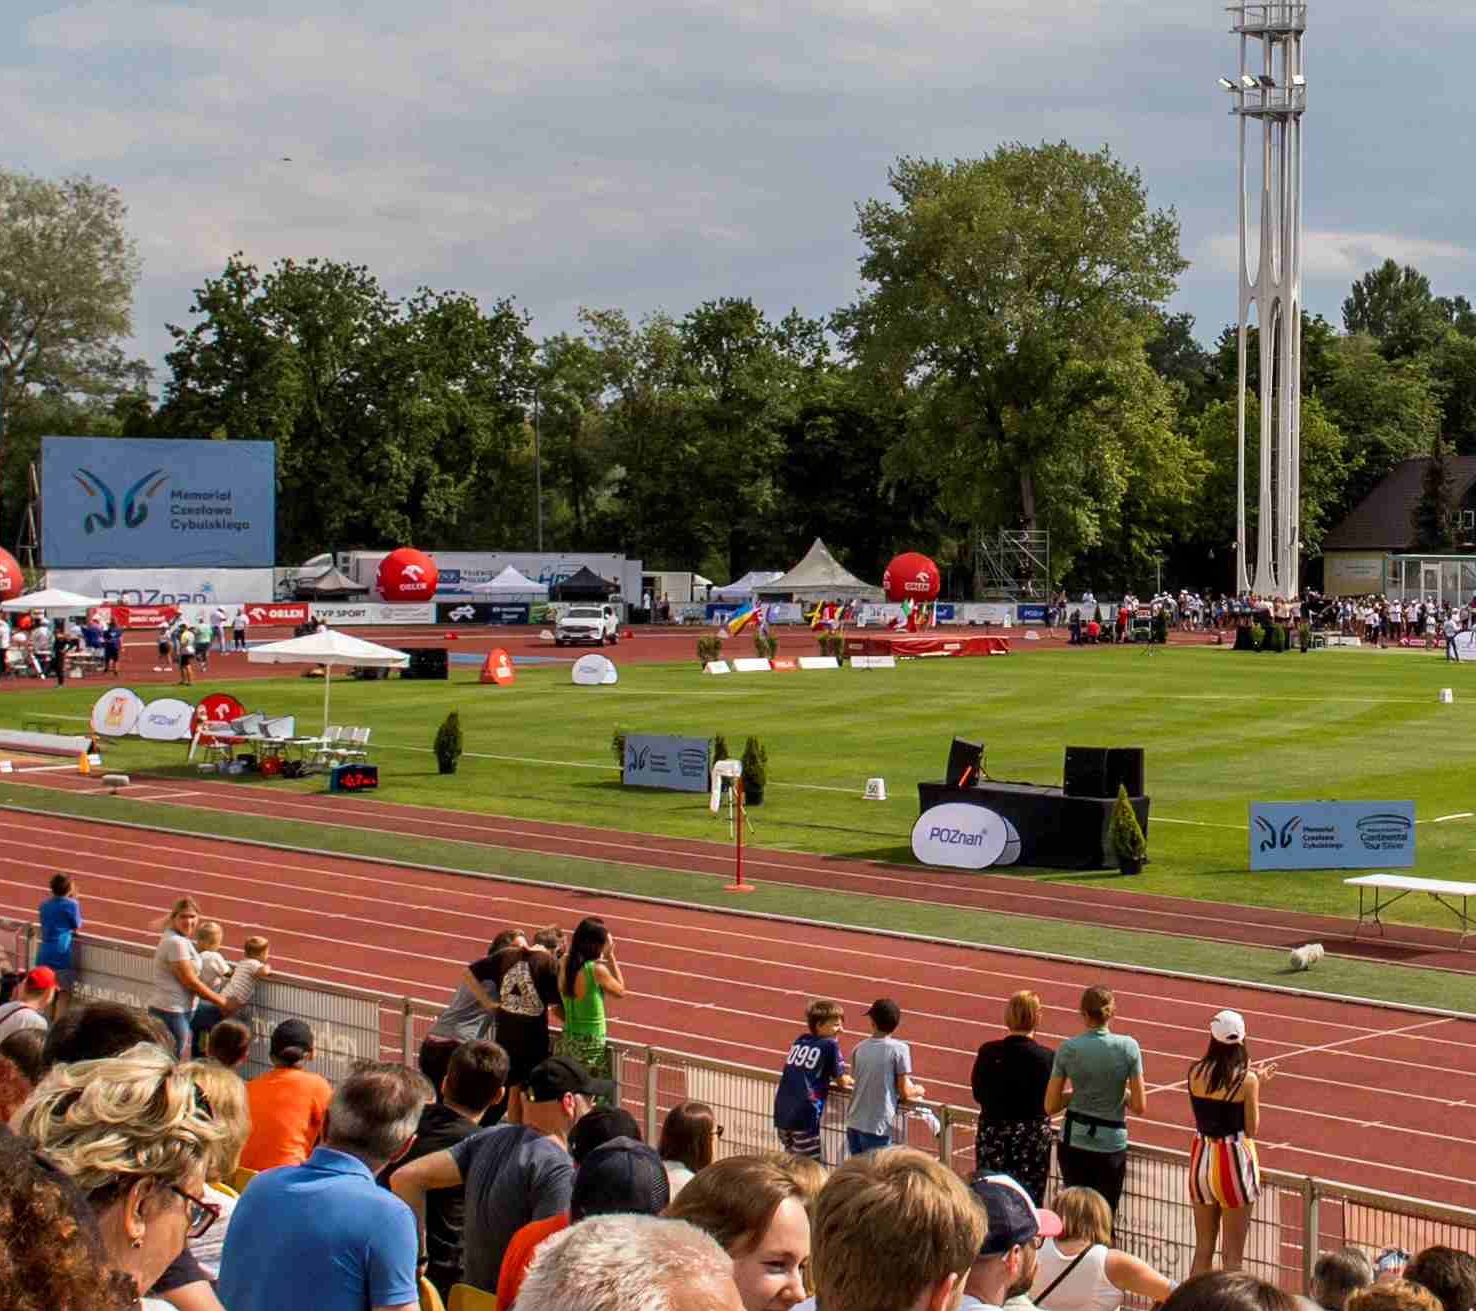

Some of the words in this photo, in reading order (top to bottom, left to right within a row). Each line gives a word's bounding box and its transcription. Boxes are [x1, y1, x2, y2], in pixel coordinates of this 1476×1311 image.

[170, 519, 251, 532] Cybulskiego
[268, 609, 304, 618] ORLEN
[315, 609, 333, 617] TVP
[336, 609, 366, 617] SPORT
[930, 827, 983, 847] POZnan
